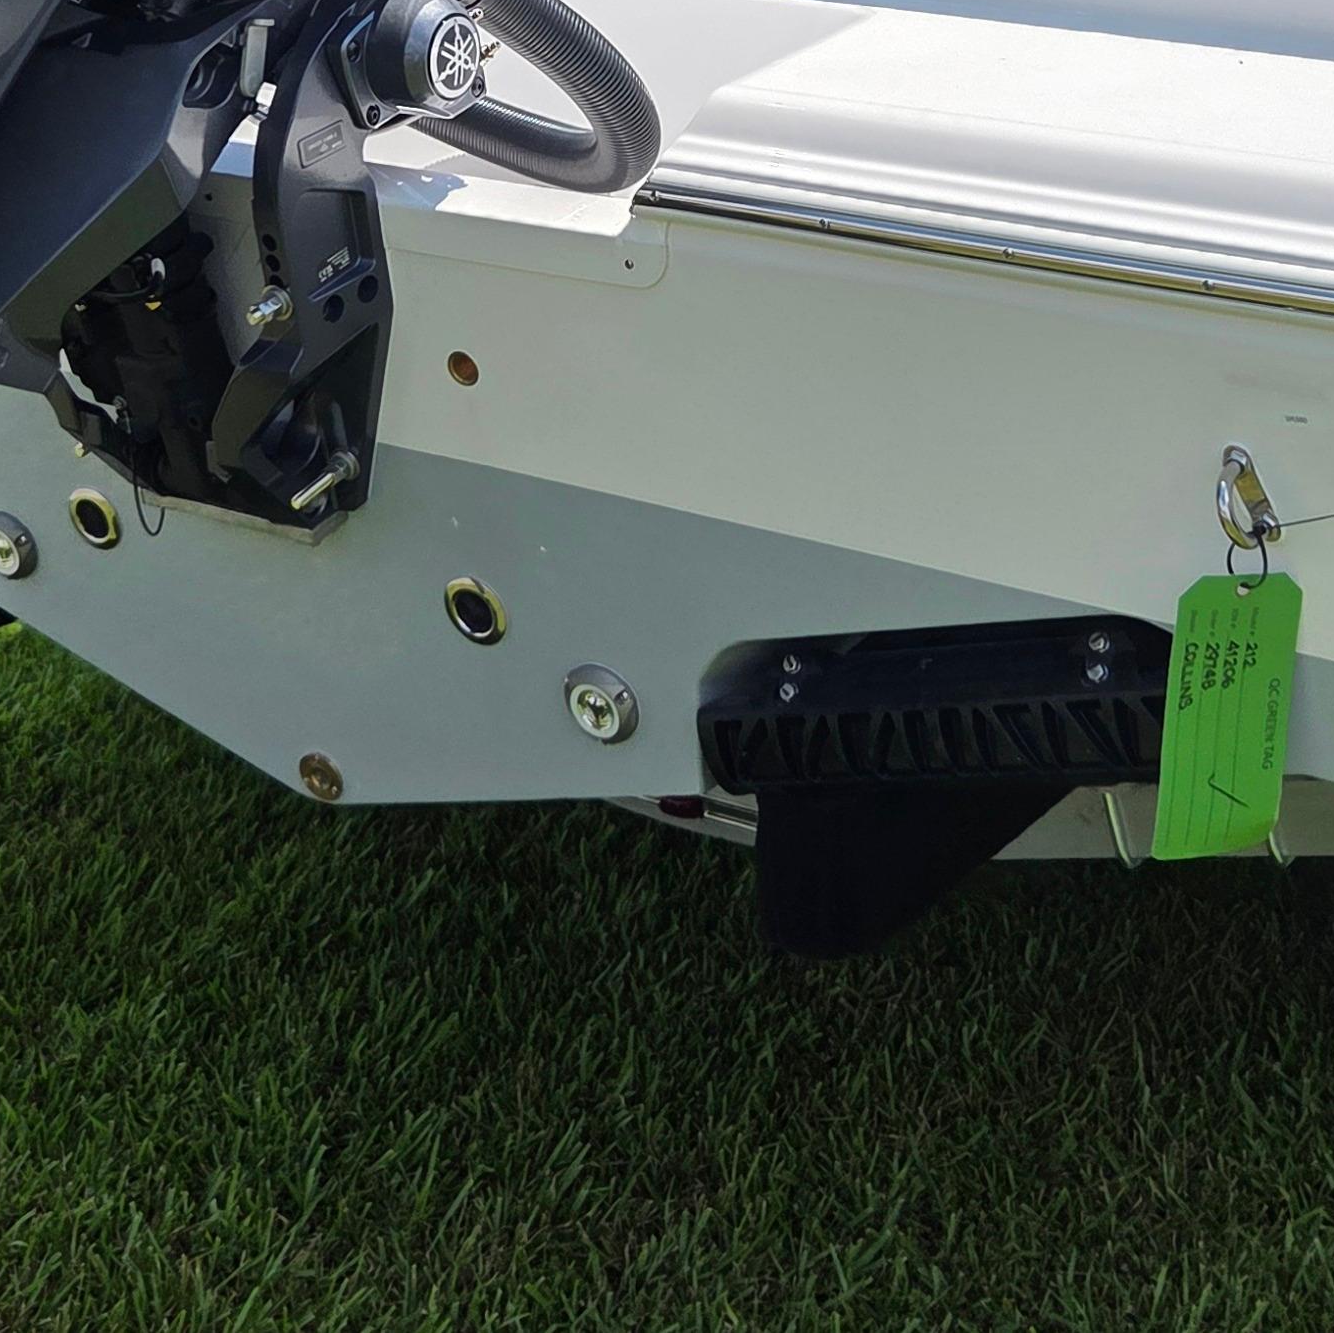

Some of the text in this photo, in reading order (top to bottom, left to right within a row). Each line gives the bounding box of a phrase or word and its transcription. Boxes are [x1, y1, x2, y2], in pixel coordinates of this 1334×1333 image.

[1178, 642, 1199, 710] COLLINS
[1201, 642, 1220, 691] 29748
[1221, 640, 1240, 689] 41206
[1244, 642, 1258, 668] 212
[1262, 678, 1281, 770] QC GREEN TAG
